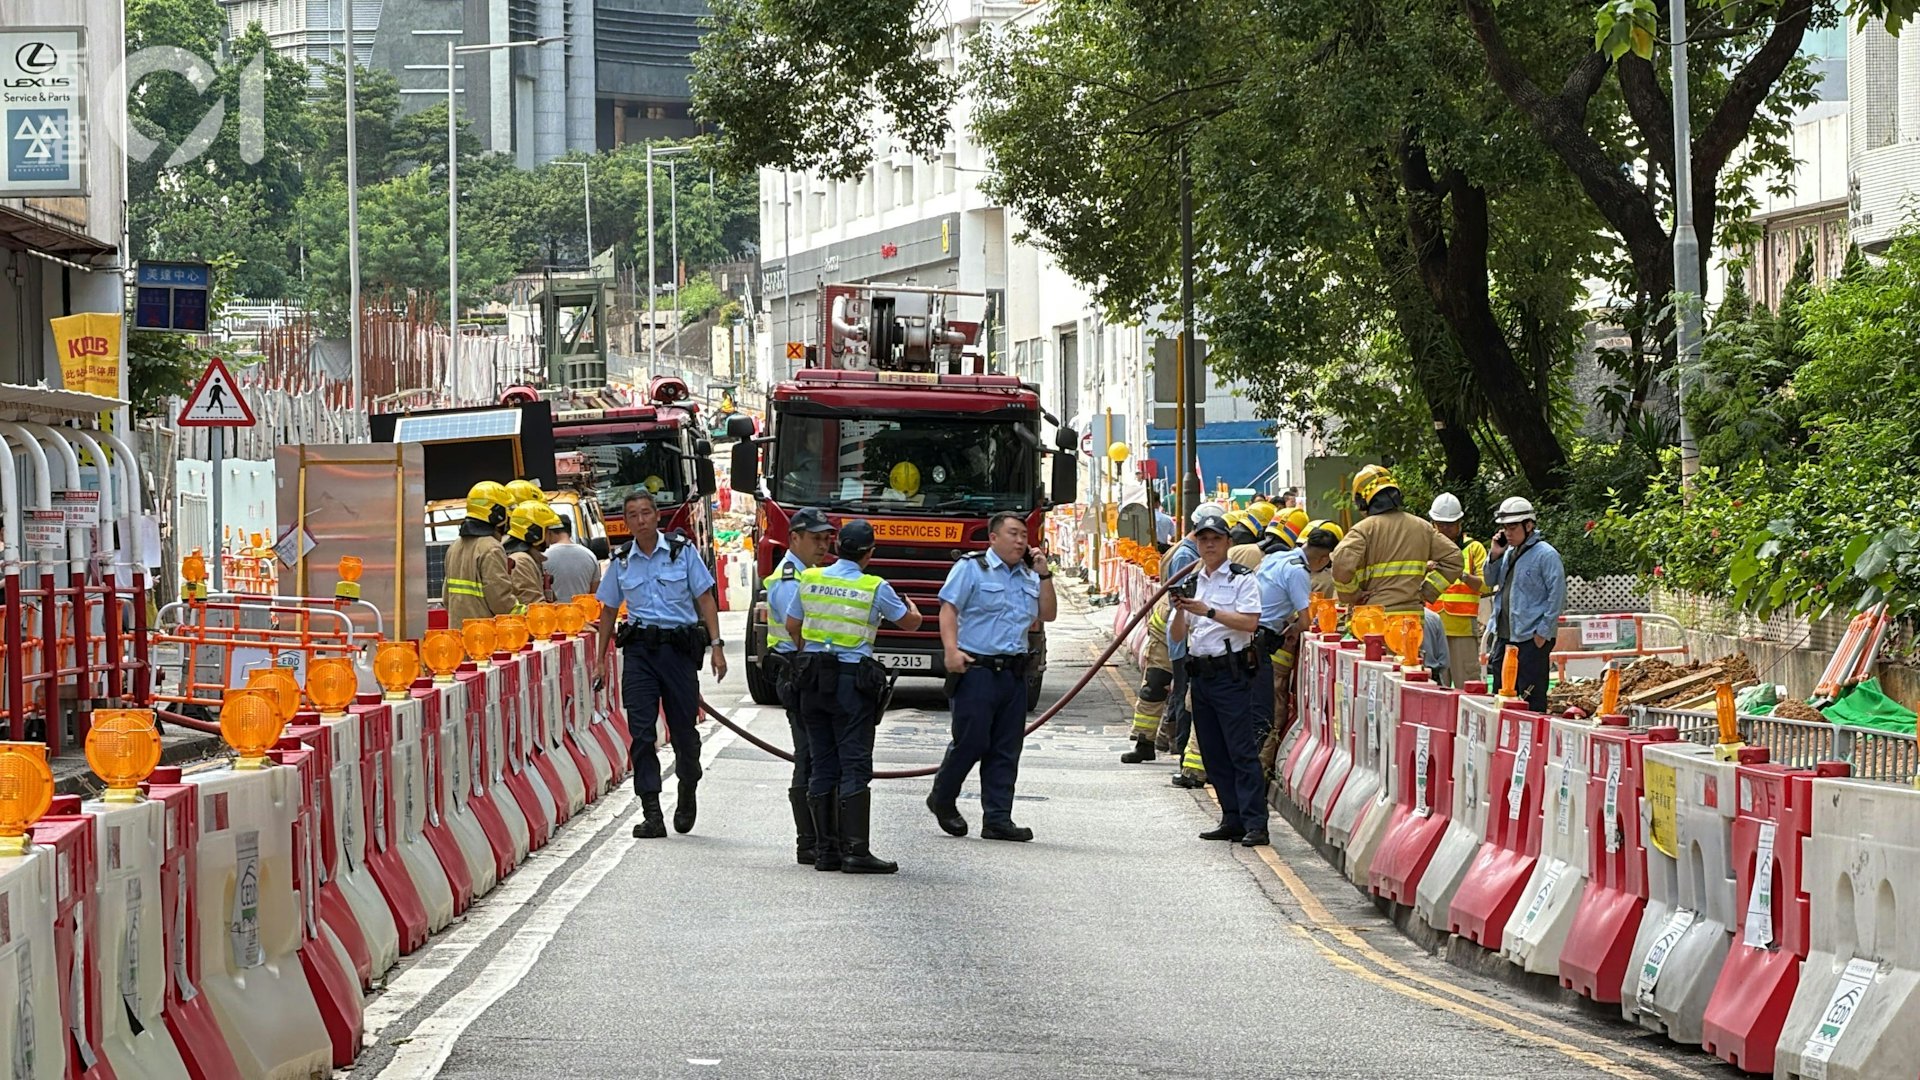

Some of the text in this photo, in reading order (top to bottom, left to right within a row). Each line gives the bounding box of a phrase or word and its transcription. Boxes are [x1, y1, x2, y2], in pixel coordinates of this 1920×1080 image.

[3, 77, 70, 88] LEXUS
[3, 91, 71, 102] Service & Parts
[67, 336, 109, 359] KMB
[888, 374, 928, 384] FIRE
[873, 524, 958, 539] RE SERVICES 防
[819, 585, 848, 597] POLICE
[277, 656, 300, 666] EDD
[891, 656, 922, 667] 2313
[1648, 944, 1667, 966] CEDD
[1826, 1003, 1852, 1026] CEDD
